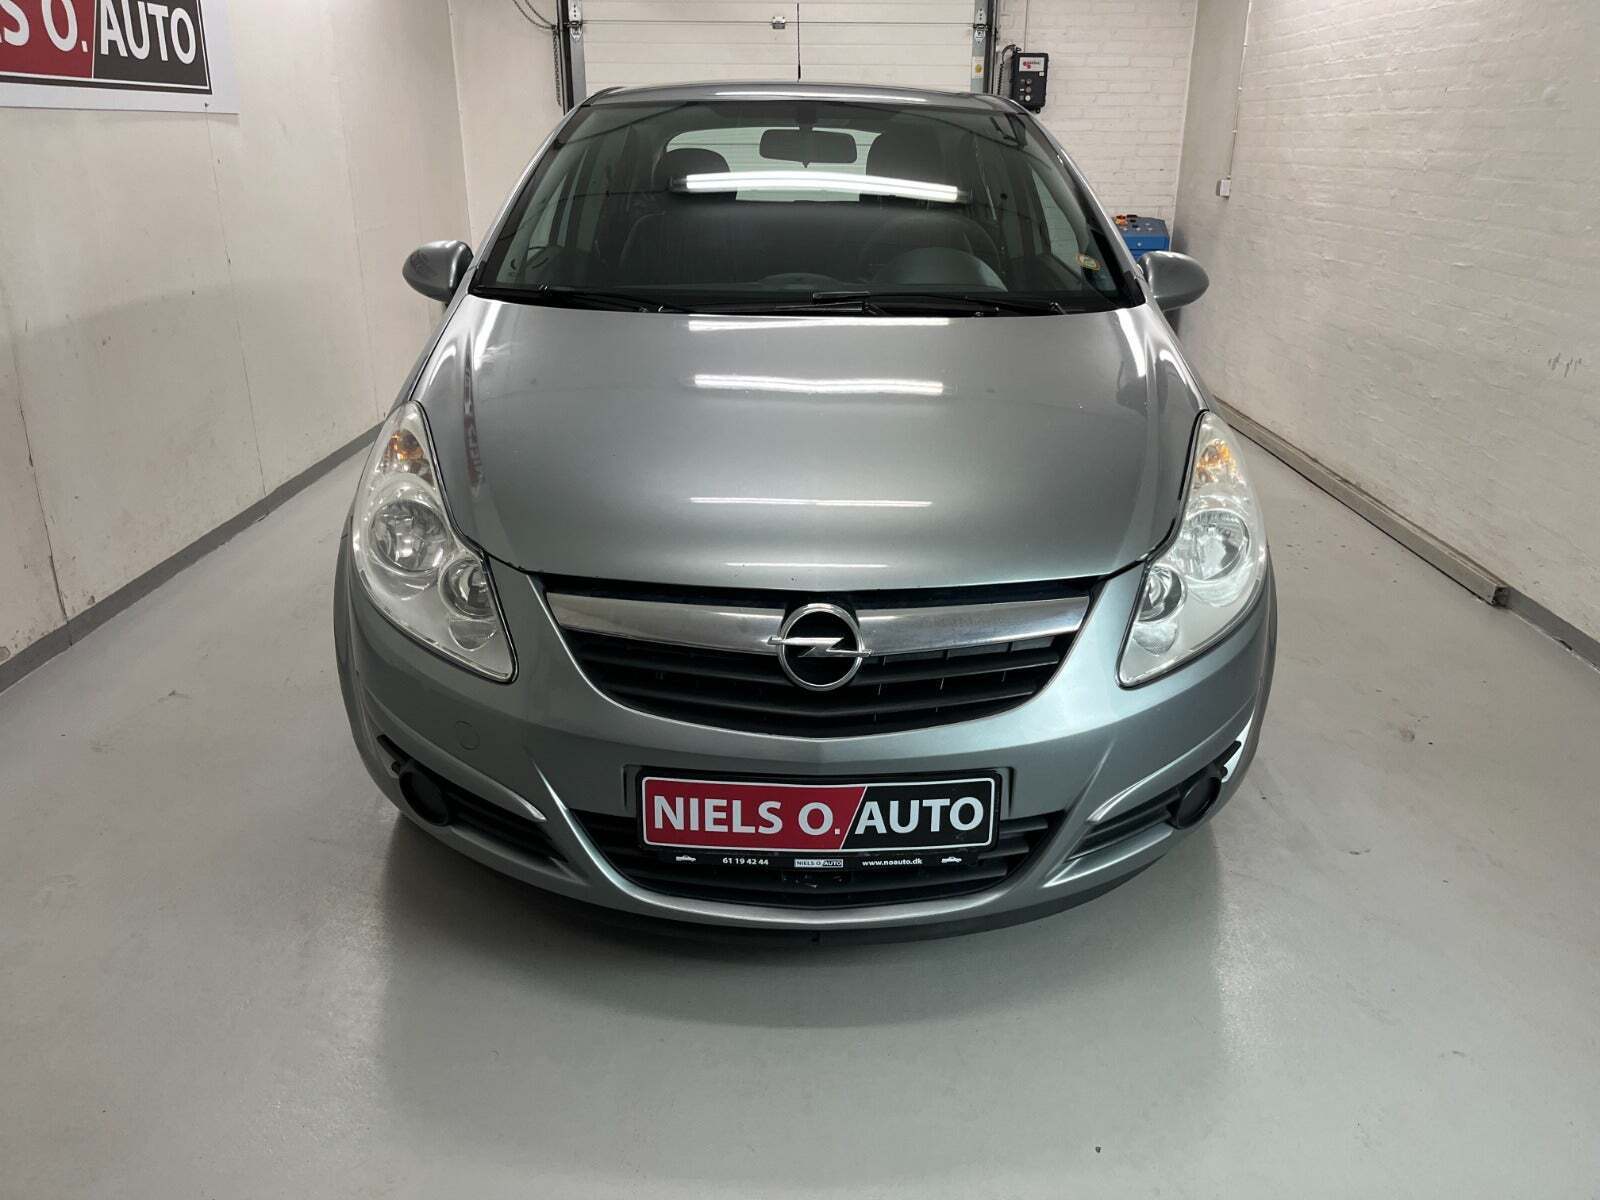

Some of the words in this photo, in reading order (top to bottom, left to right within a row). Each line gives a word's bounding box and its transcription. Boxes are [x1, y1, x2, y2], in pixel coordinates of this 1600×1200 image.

[41, 0, 88, 52] O.
[100, 0, 196, 64] AUTO
[653, 795, 782, 835] NIELS
[798, 801, 841, 836] O.
[854, 796, 984, 835] AUTO
[722, 857, 732, 865] 61
[734, 857, 745, 865] 19
[862, 857, 923, 866] www.noauto.dk
